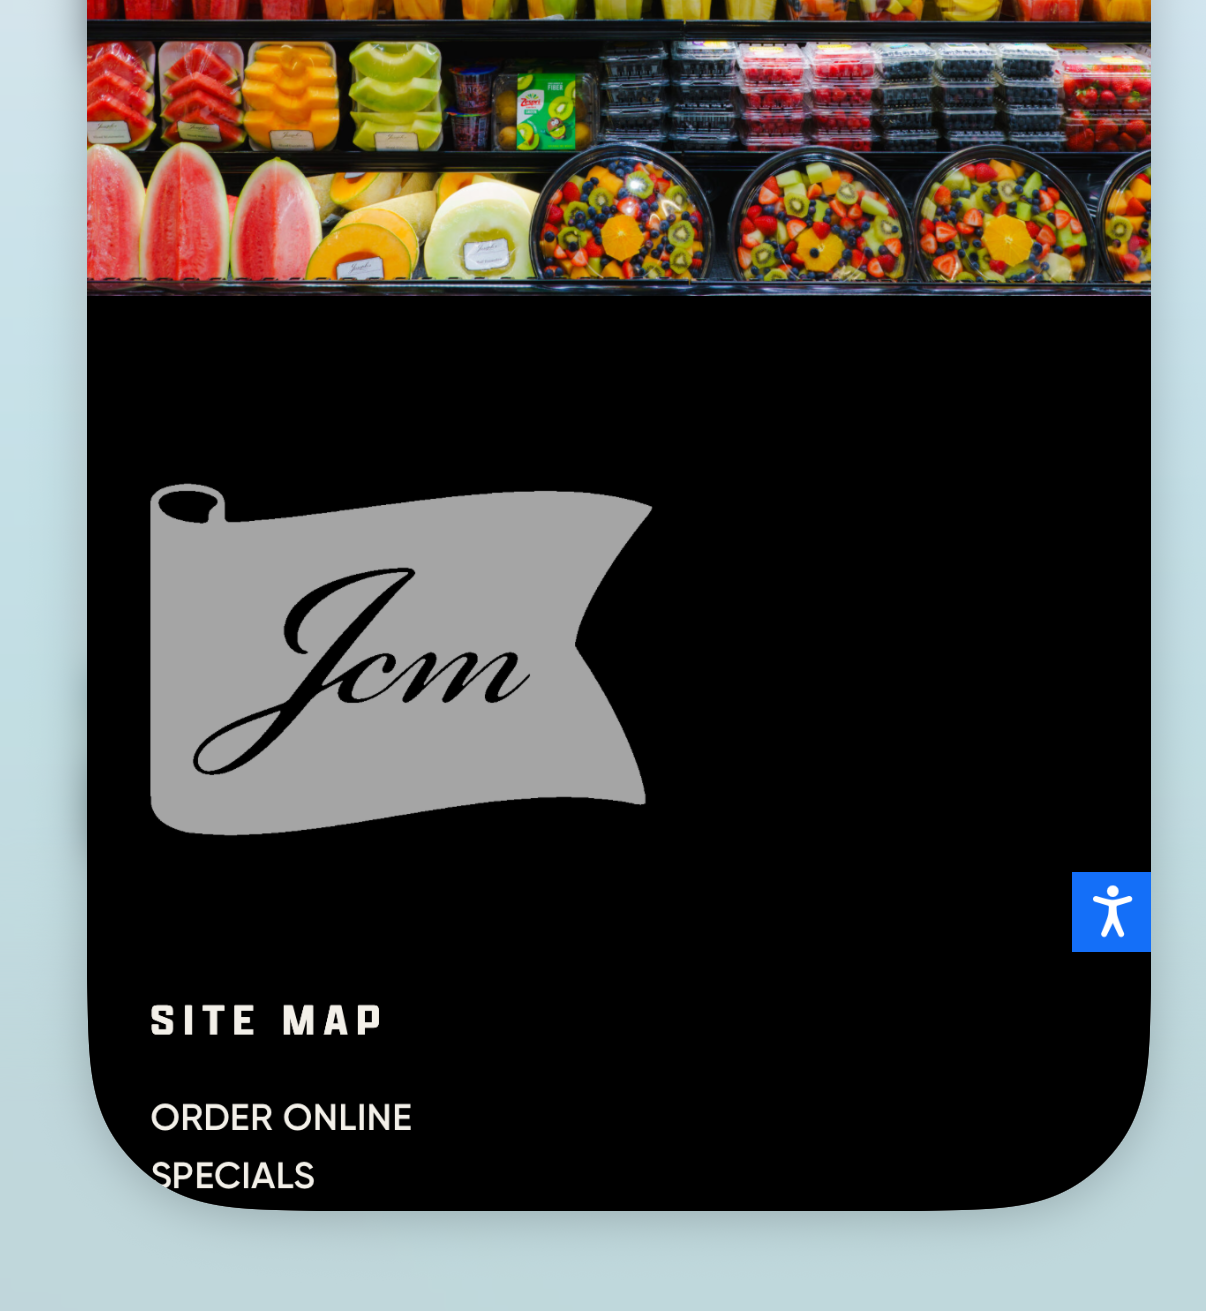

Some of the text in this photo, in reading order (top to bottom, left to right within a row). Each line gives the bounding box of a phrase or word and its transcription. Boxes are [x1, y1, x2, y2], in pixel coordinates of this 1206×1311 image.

[192, 567, 531, 776] Jcm
[150, 1004, 380, 1036] SITE MAP
[150, 1102, 412, 1132] ORDER ONLINE
[152, 1161, 315, 1189] SPECIALS
